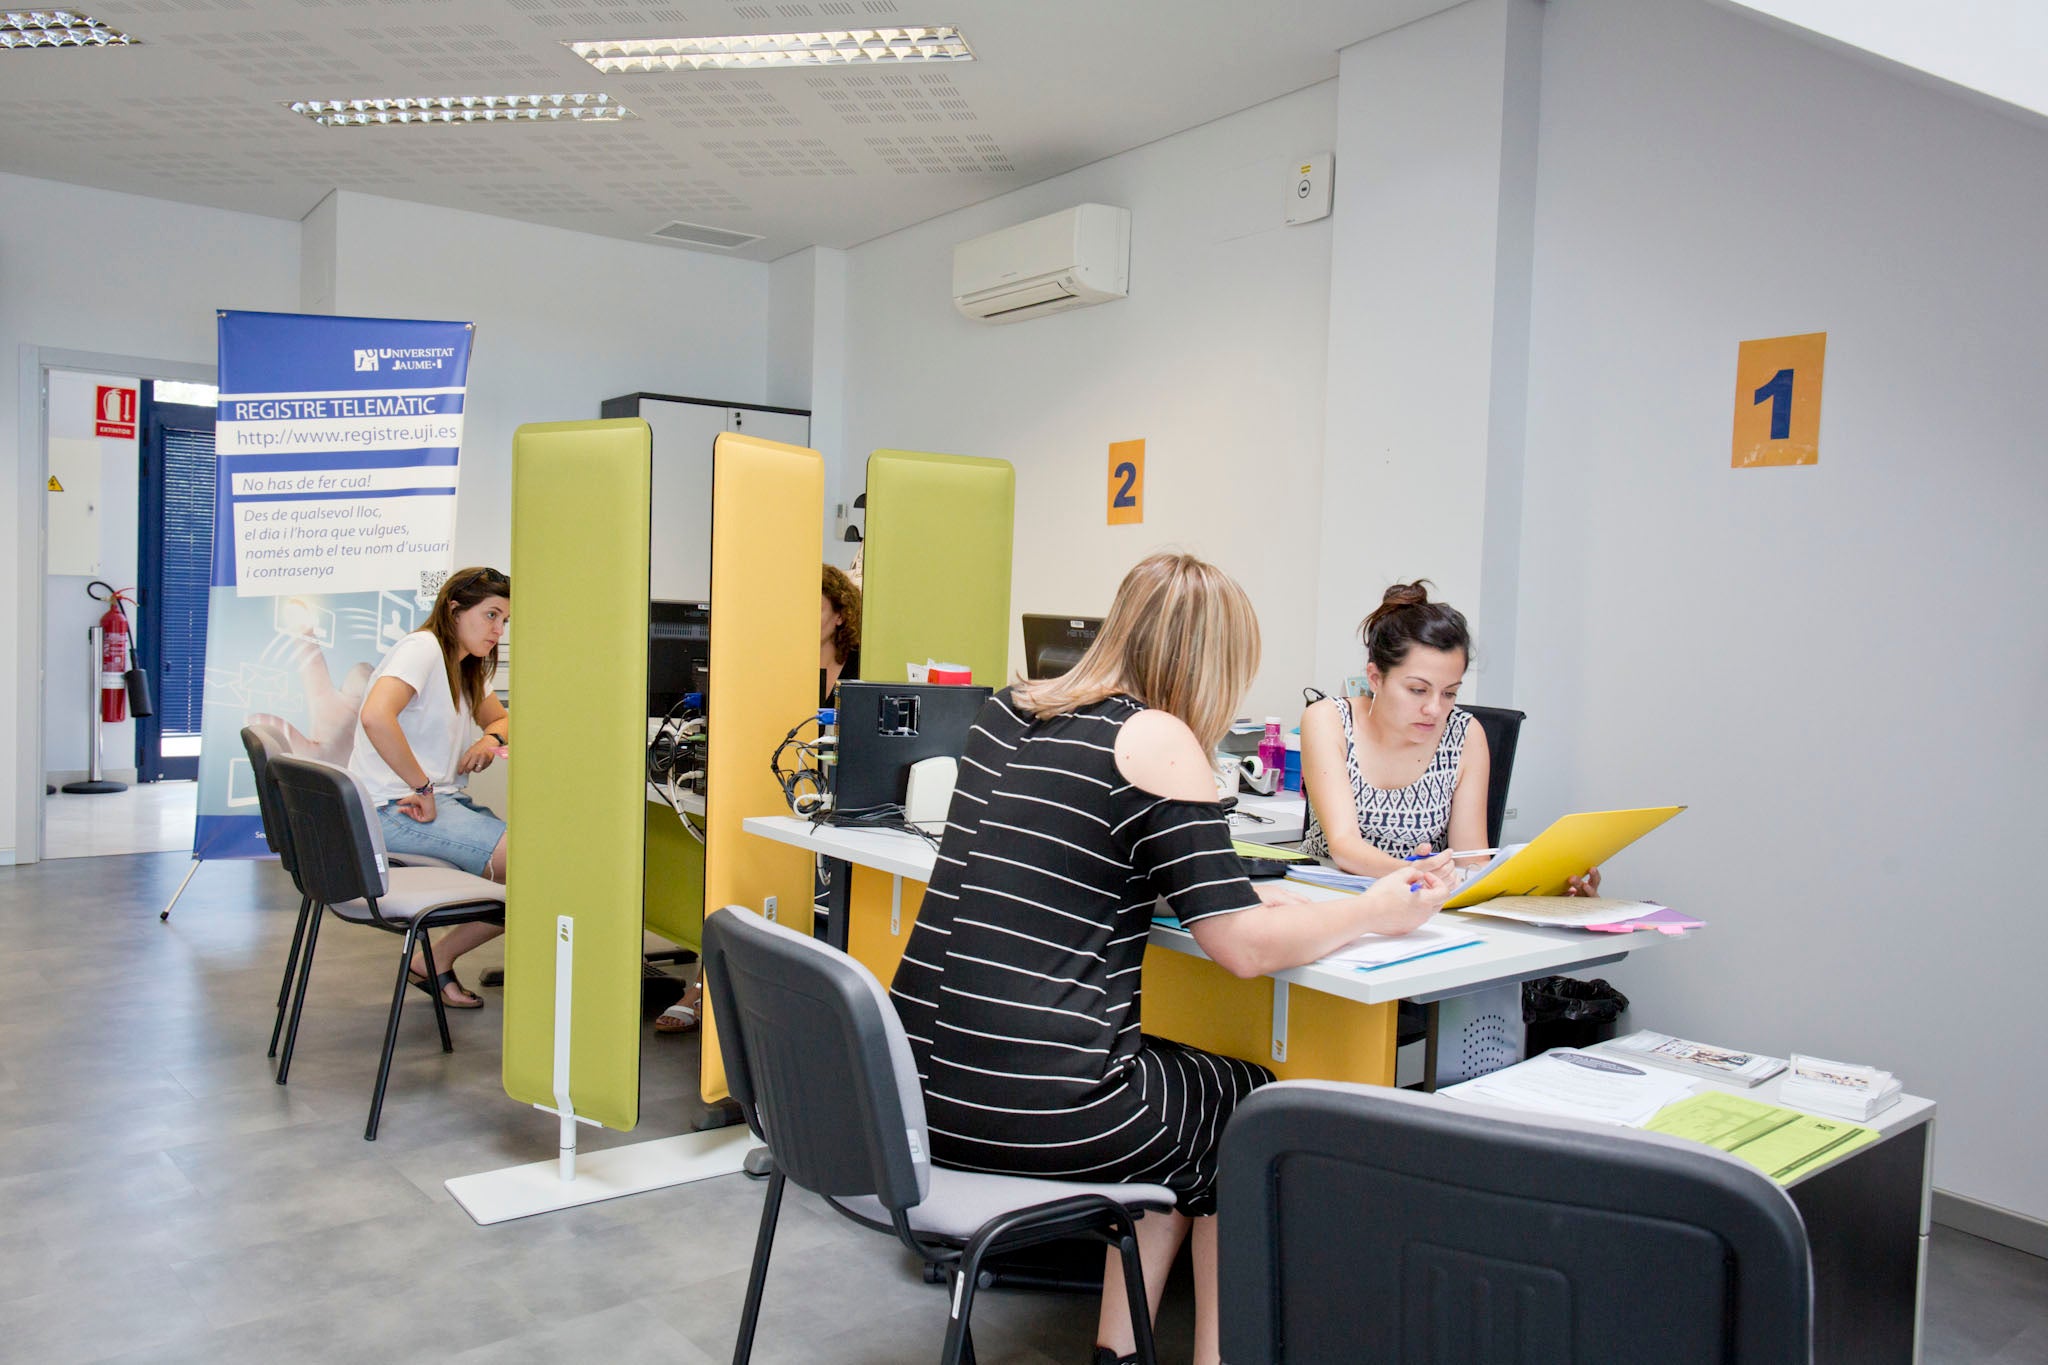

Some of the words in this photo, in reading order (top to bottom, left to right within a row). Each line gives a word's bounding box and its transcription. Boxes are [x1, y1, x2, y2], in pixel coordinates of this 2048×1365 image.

[235, 400, 328, 420] REGISTRE
[331, 395, 436, 417] TELEMÀTIC
[1753, 368, 1794, 440] 1
[237, 424, 457, 449] http://www.registre.uji.es
[243, 478, 264, 491] No
[267, 477, 293, 490] has
[296, 476, 314, 489] de
[318, 475, 338, 488] fer
[340, 474, 372, 488] cua!
[1112, 461, 1137, 508] 2
[244, 509, 268, 521] Des
[271, 509, 288, 520] de
[290, 506, 354, 522] qualsevol
[356, 505, 382, 519] lloc,
[244, 528, 257, 541] el
[259, 527, 280, 540] dia
[283, 527, 288, 539] i
[290, 525, 328, 539] l'hora
[331, 527, 356, 540] que
[358, 523, 410, 539] vulgues,
[245, 547, 290, 559] només
[293, 545, 323, 557] amb
[326, 544, 338, 556] el
[341, 545, 362, 556] teu
[364, 543, 393, 554] nom
[396, 540, 450, 553] d'usuari
[246, 566, 251, 578] i
[252, 565, 335, 579] contrasenya
